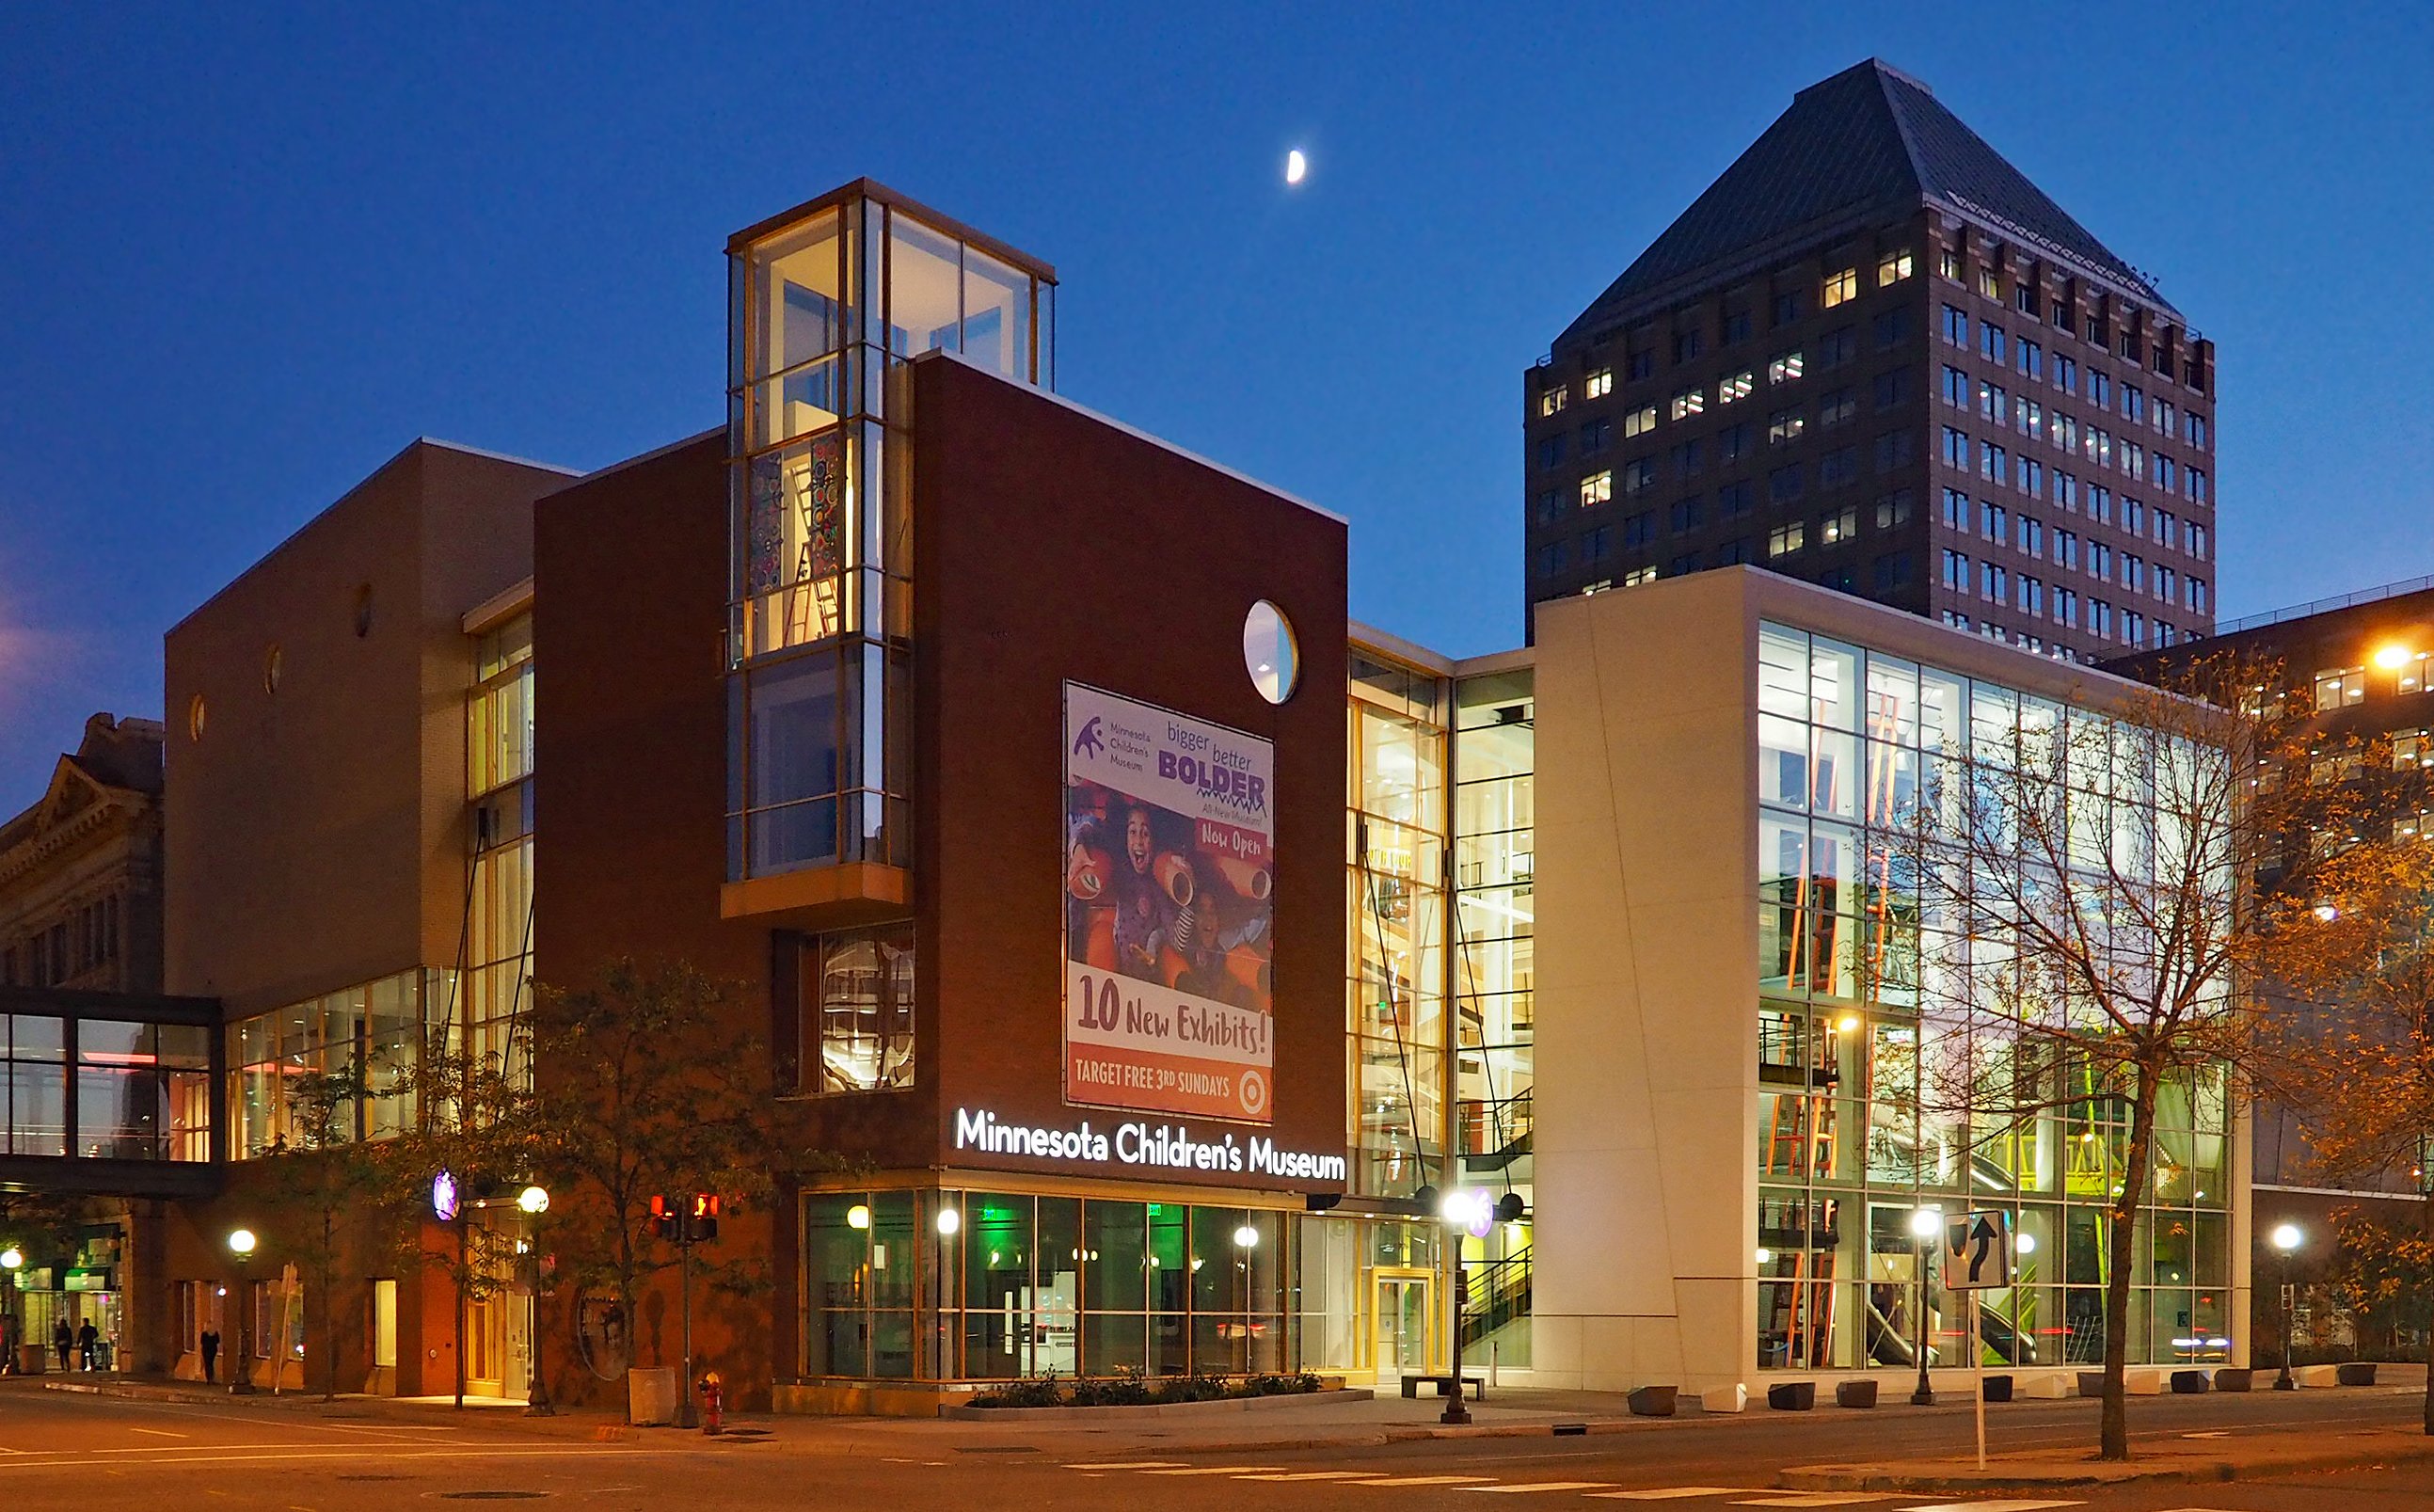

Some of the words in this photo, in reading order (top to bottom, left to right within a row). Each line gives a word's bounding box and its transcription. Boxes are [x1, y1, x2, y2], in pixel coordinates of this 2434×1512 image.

[1110, 723, 1151, 743] Minnesota
[1110, 738, 1149, 758] Children's
[1168, 721, 1210, 752] bigger
[1213, 743, 1251, 772] better
[1110, 754, 1143, 772] Museum
[1158, 749, 1265, 806] BOLDER
[1202, 822, 1228, 848] Now
[1233, 830, 1261, 859] Open
[1077, 975, 1120, 1032] 10
[1126, 997, 1169, 1038] New
[1177, 1004, 1266, 1055] Exhibits!
[1075, 1058, 1122, 1087] TARGET
[1124, 1062, 1154, 1090] FREE
[1156, 1068, 1175, 1091] 3RD
[1178, 1071, 1230, 1098] SUNDAYS
[956, 1106, 1108, 1161] Minnesota
[1116, 1122, 1242, 1172] Children's
[1249, 1137, 1345, 1181] Museum
